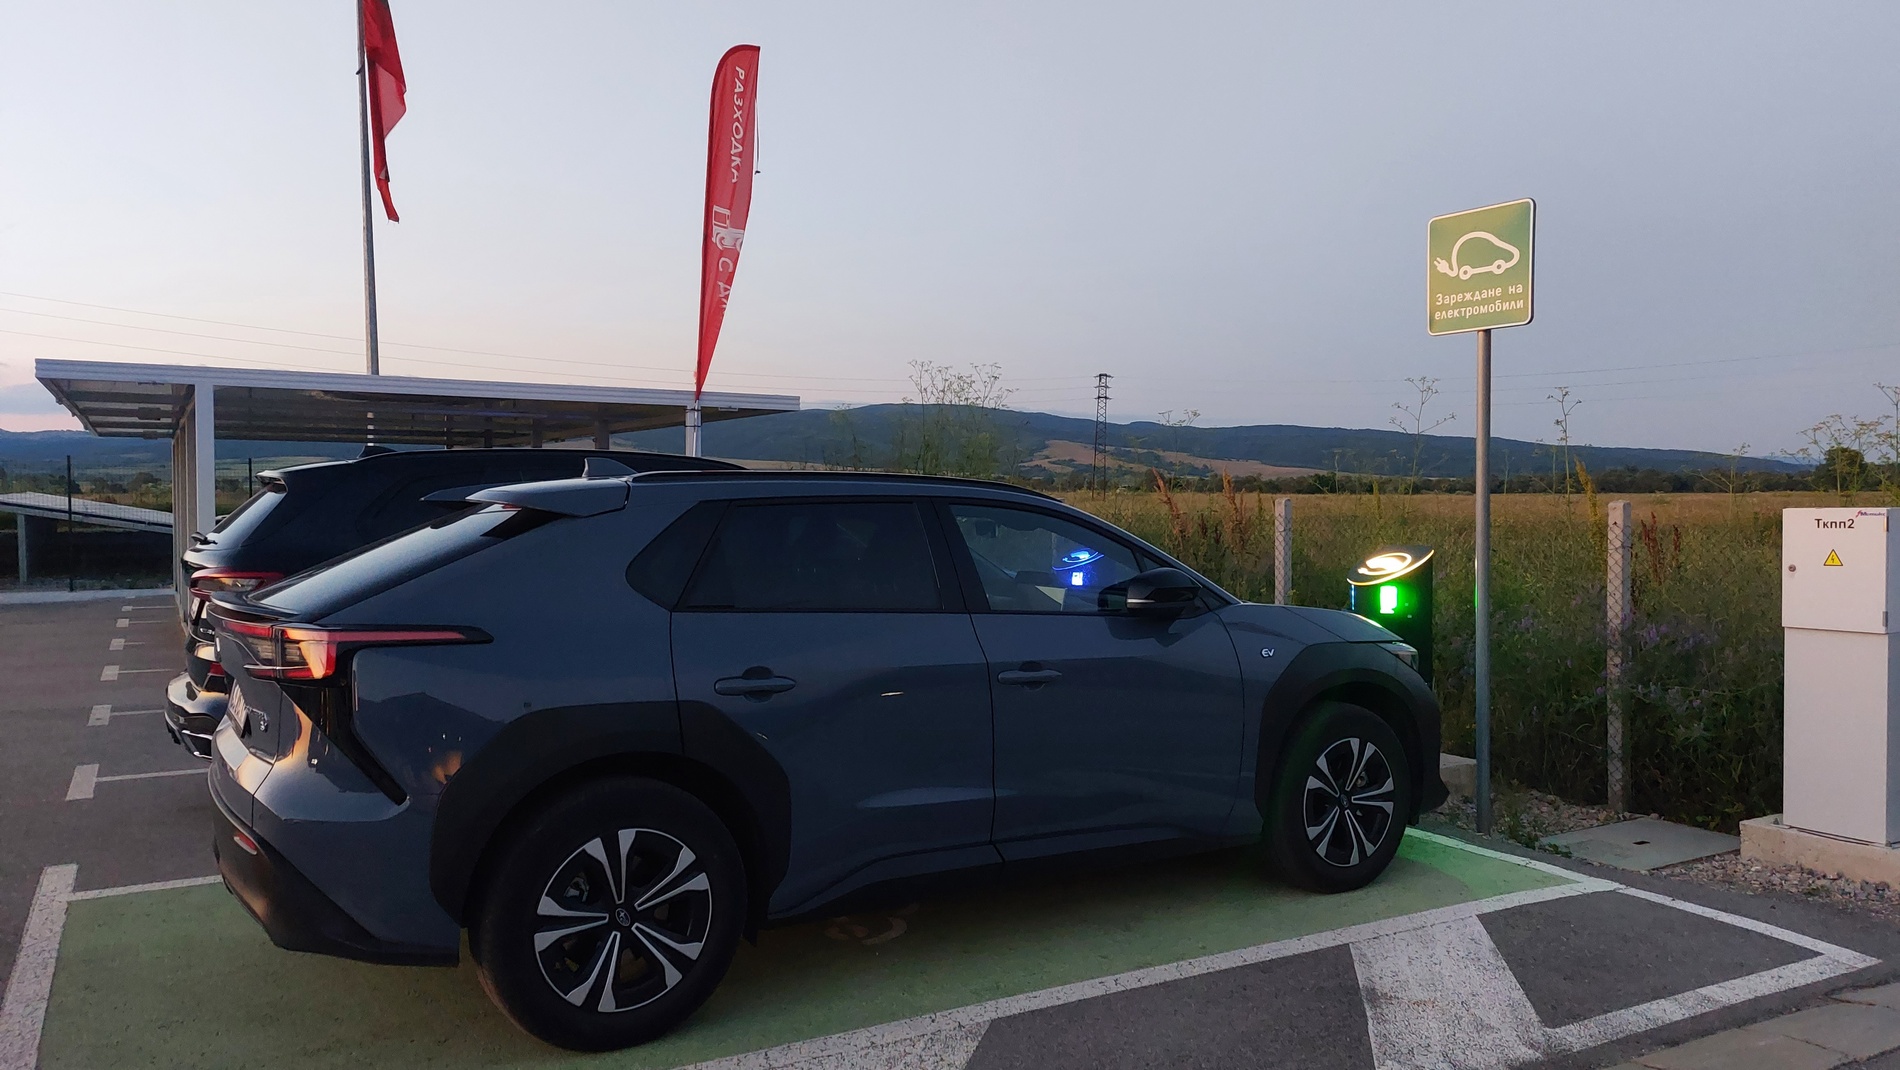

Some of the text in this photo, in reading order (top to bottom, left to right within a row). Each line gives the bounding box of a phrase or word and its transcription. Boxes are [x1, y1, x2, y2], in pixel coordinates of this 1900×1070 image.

[731, 65, 745, 184] РАЗХОДКА
[1435, 283, 1523, 307] Зареждане на
[1434, 298, 1524, 321] електромобили
[1261, 648, 1275, 657] EV
